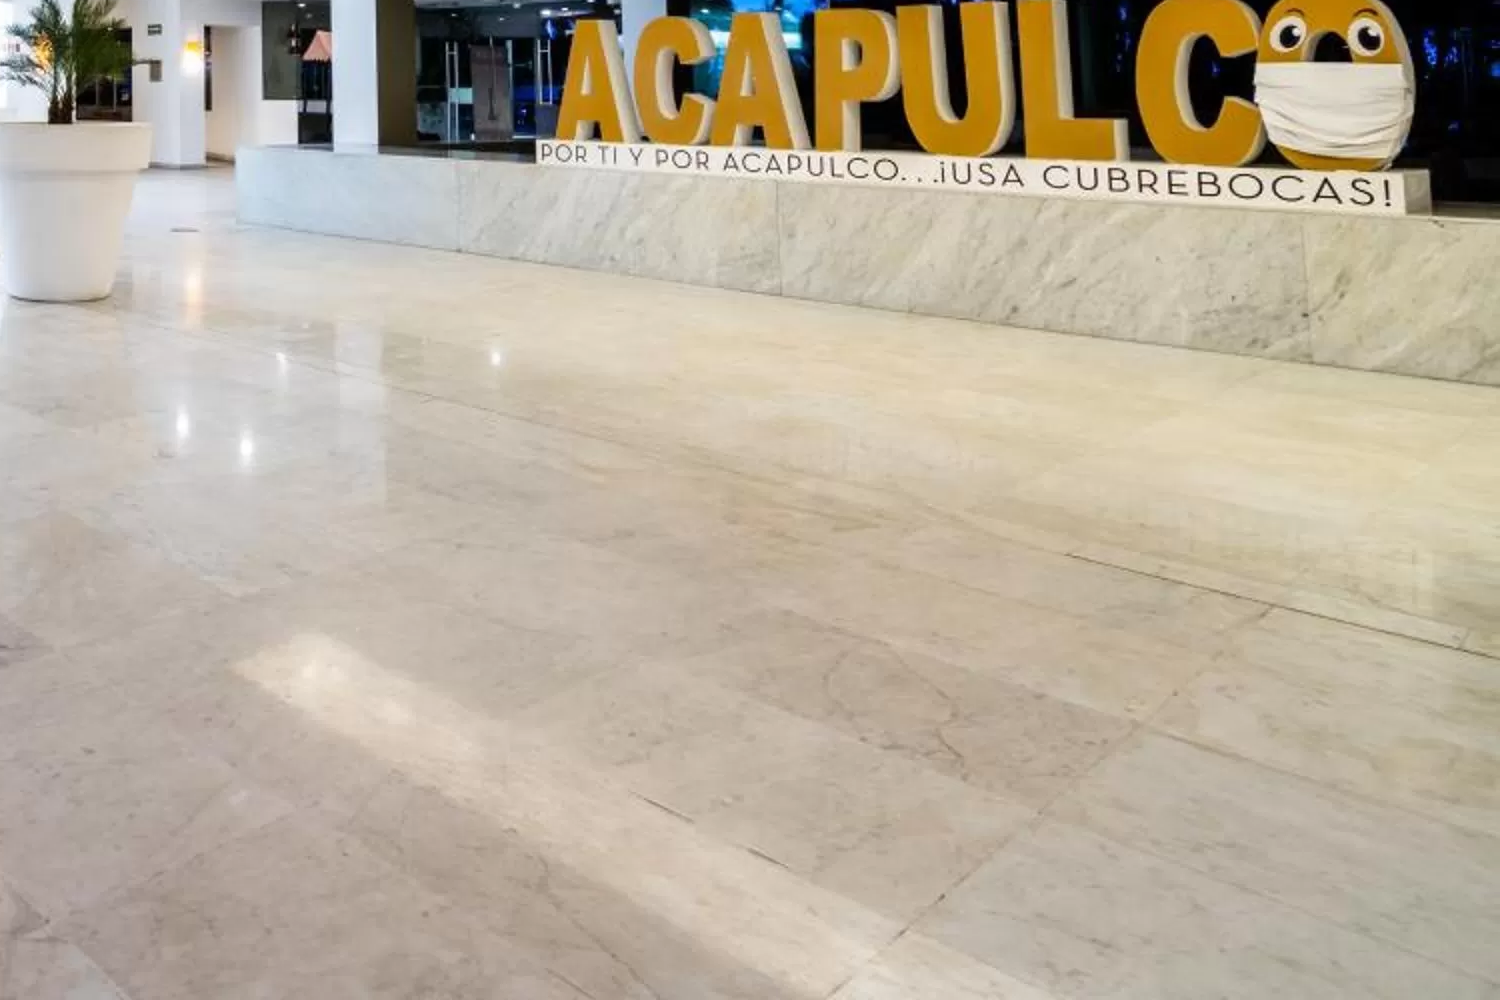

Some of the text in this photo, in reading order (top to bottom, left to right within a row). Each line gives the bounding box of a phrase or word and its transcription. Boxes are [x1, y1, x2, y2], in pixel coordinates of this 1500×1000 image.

[541, 143, 587, 163] POR
[598, 145, 617, 165] TI
[630, 147, 644, 166] Y
[655, 148, 709, 171] POR
[1043, 164, 1393, 208] CUBREBOCAS!
